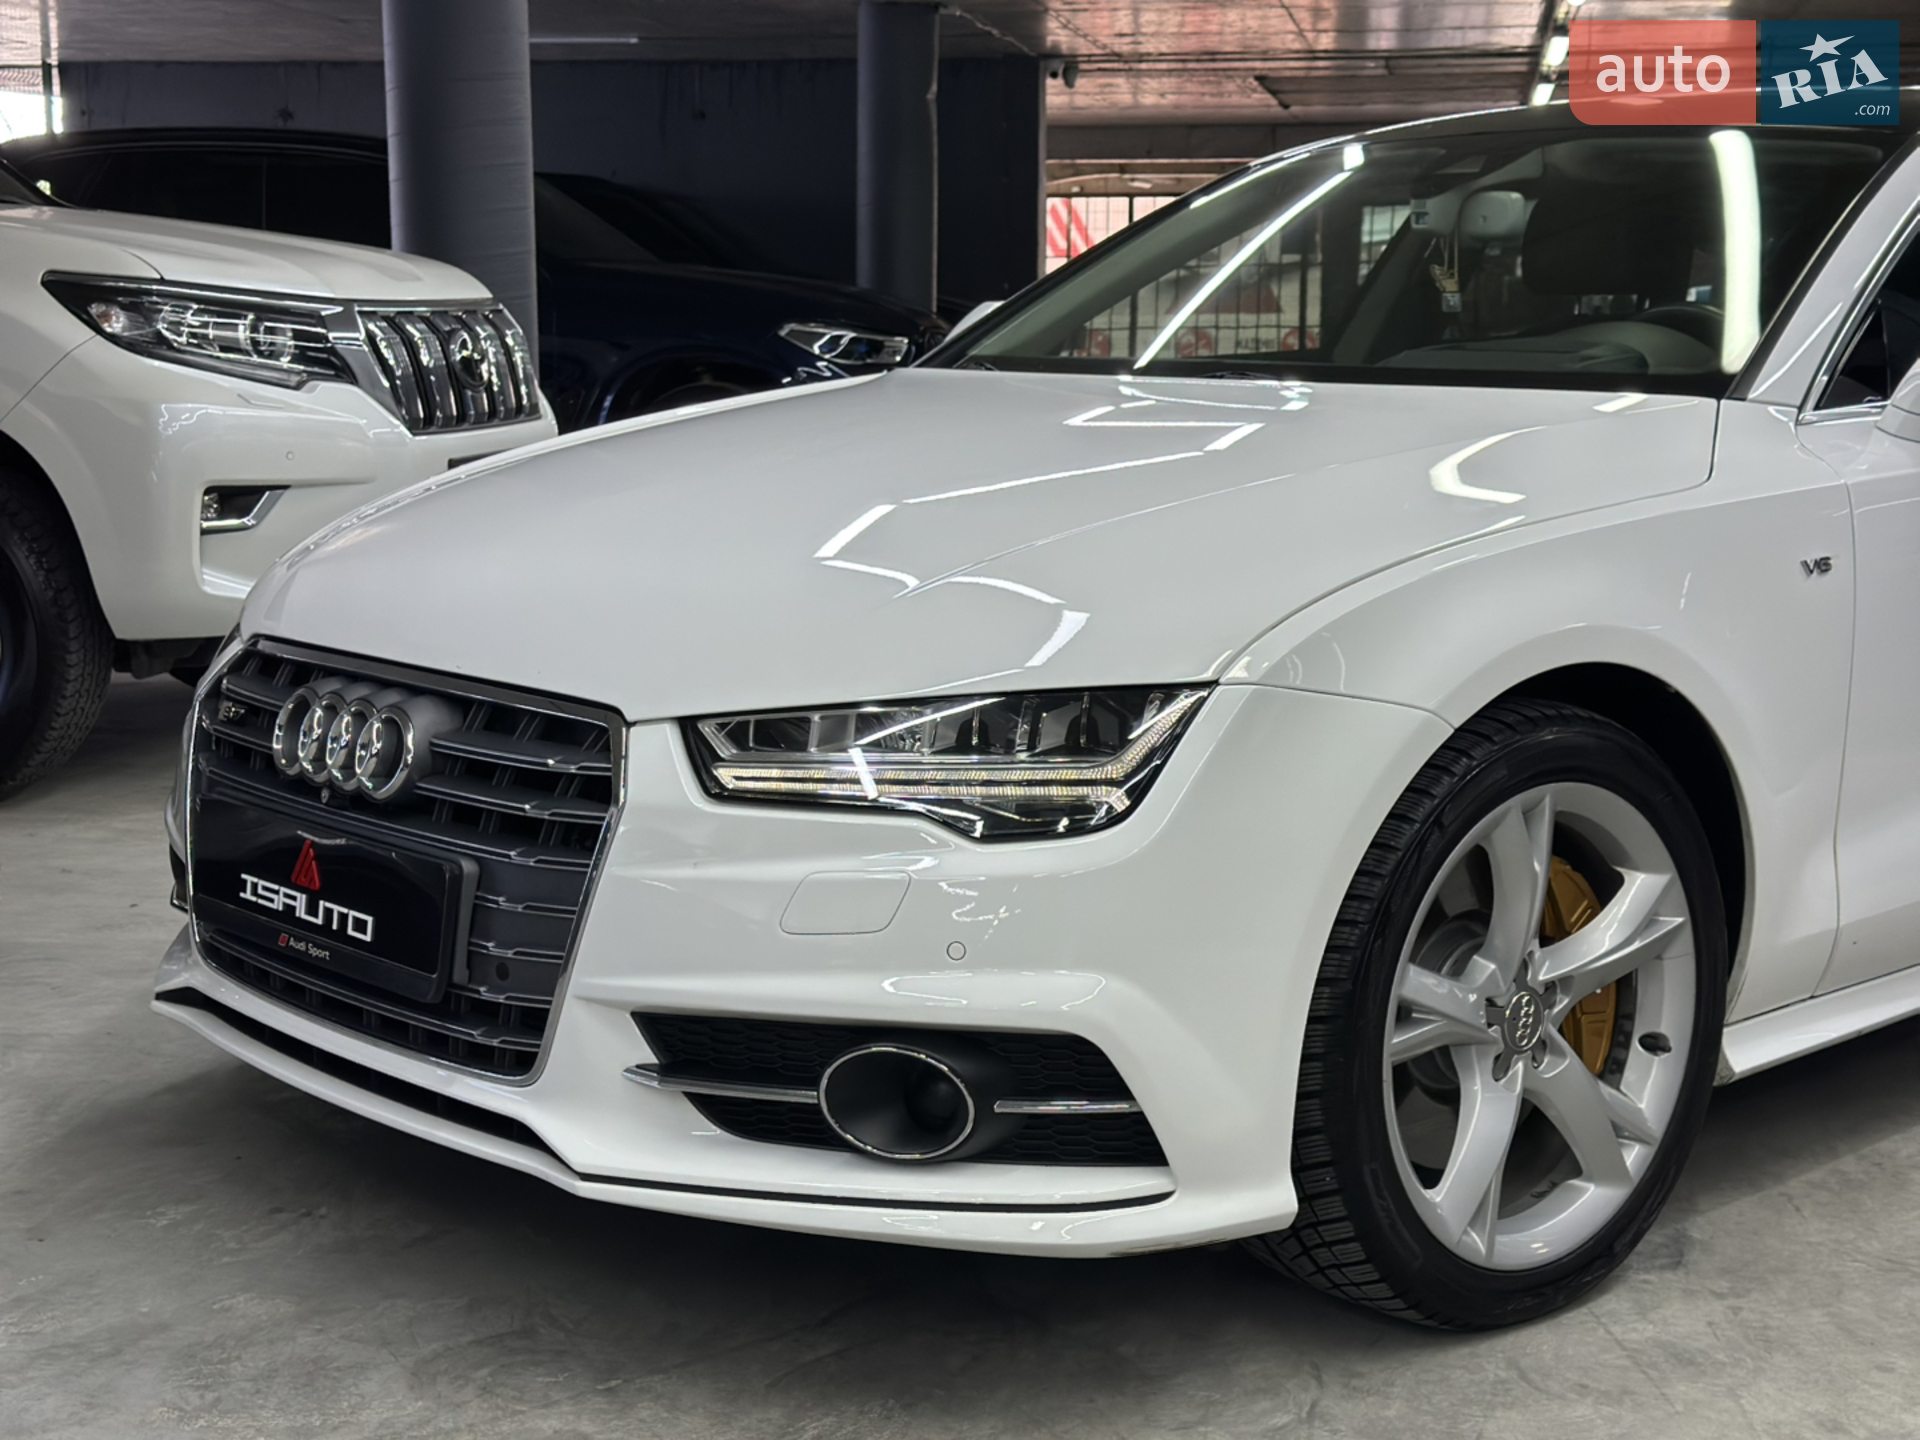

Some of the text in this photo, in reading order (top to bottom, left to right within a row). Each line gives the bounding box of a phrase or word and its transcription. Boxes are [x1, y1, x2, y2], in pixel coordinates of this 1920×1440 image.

[1800, 556, 1832, 577] V6
[239, 873, 374, 942] ISAUTO
[289, 936, 330, 960] Audi Sport
